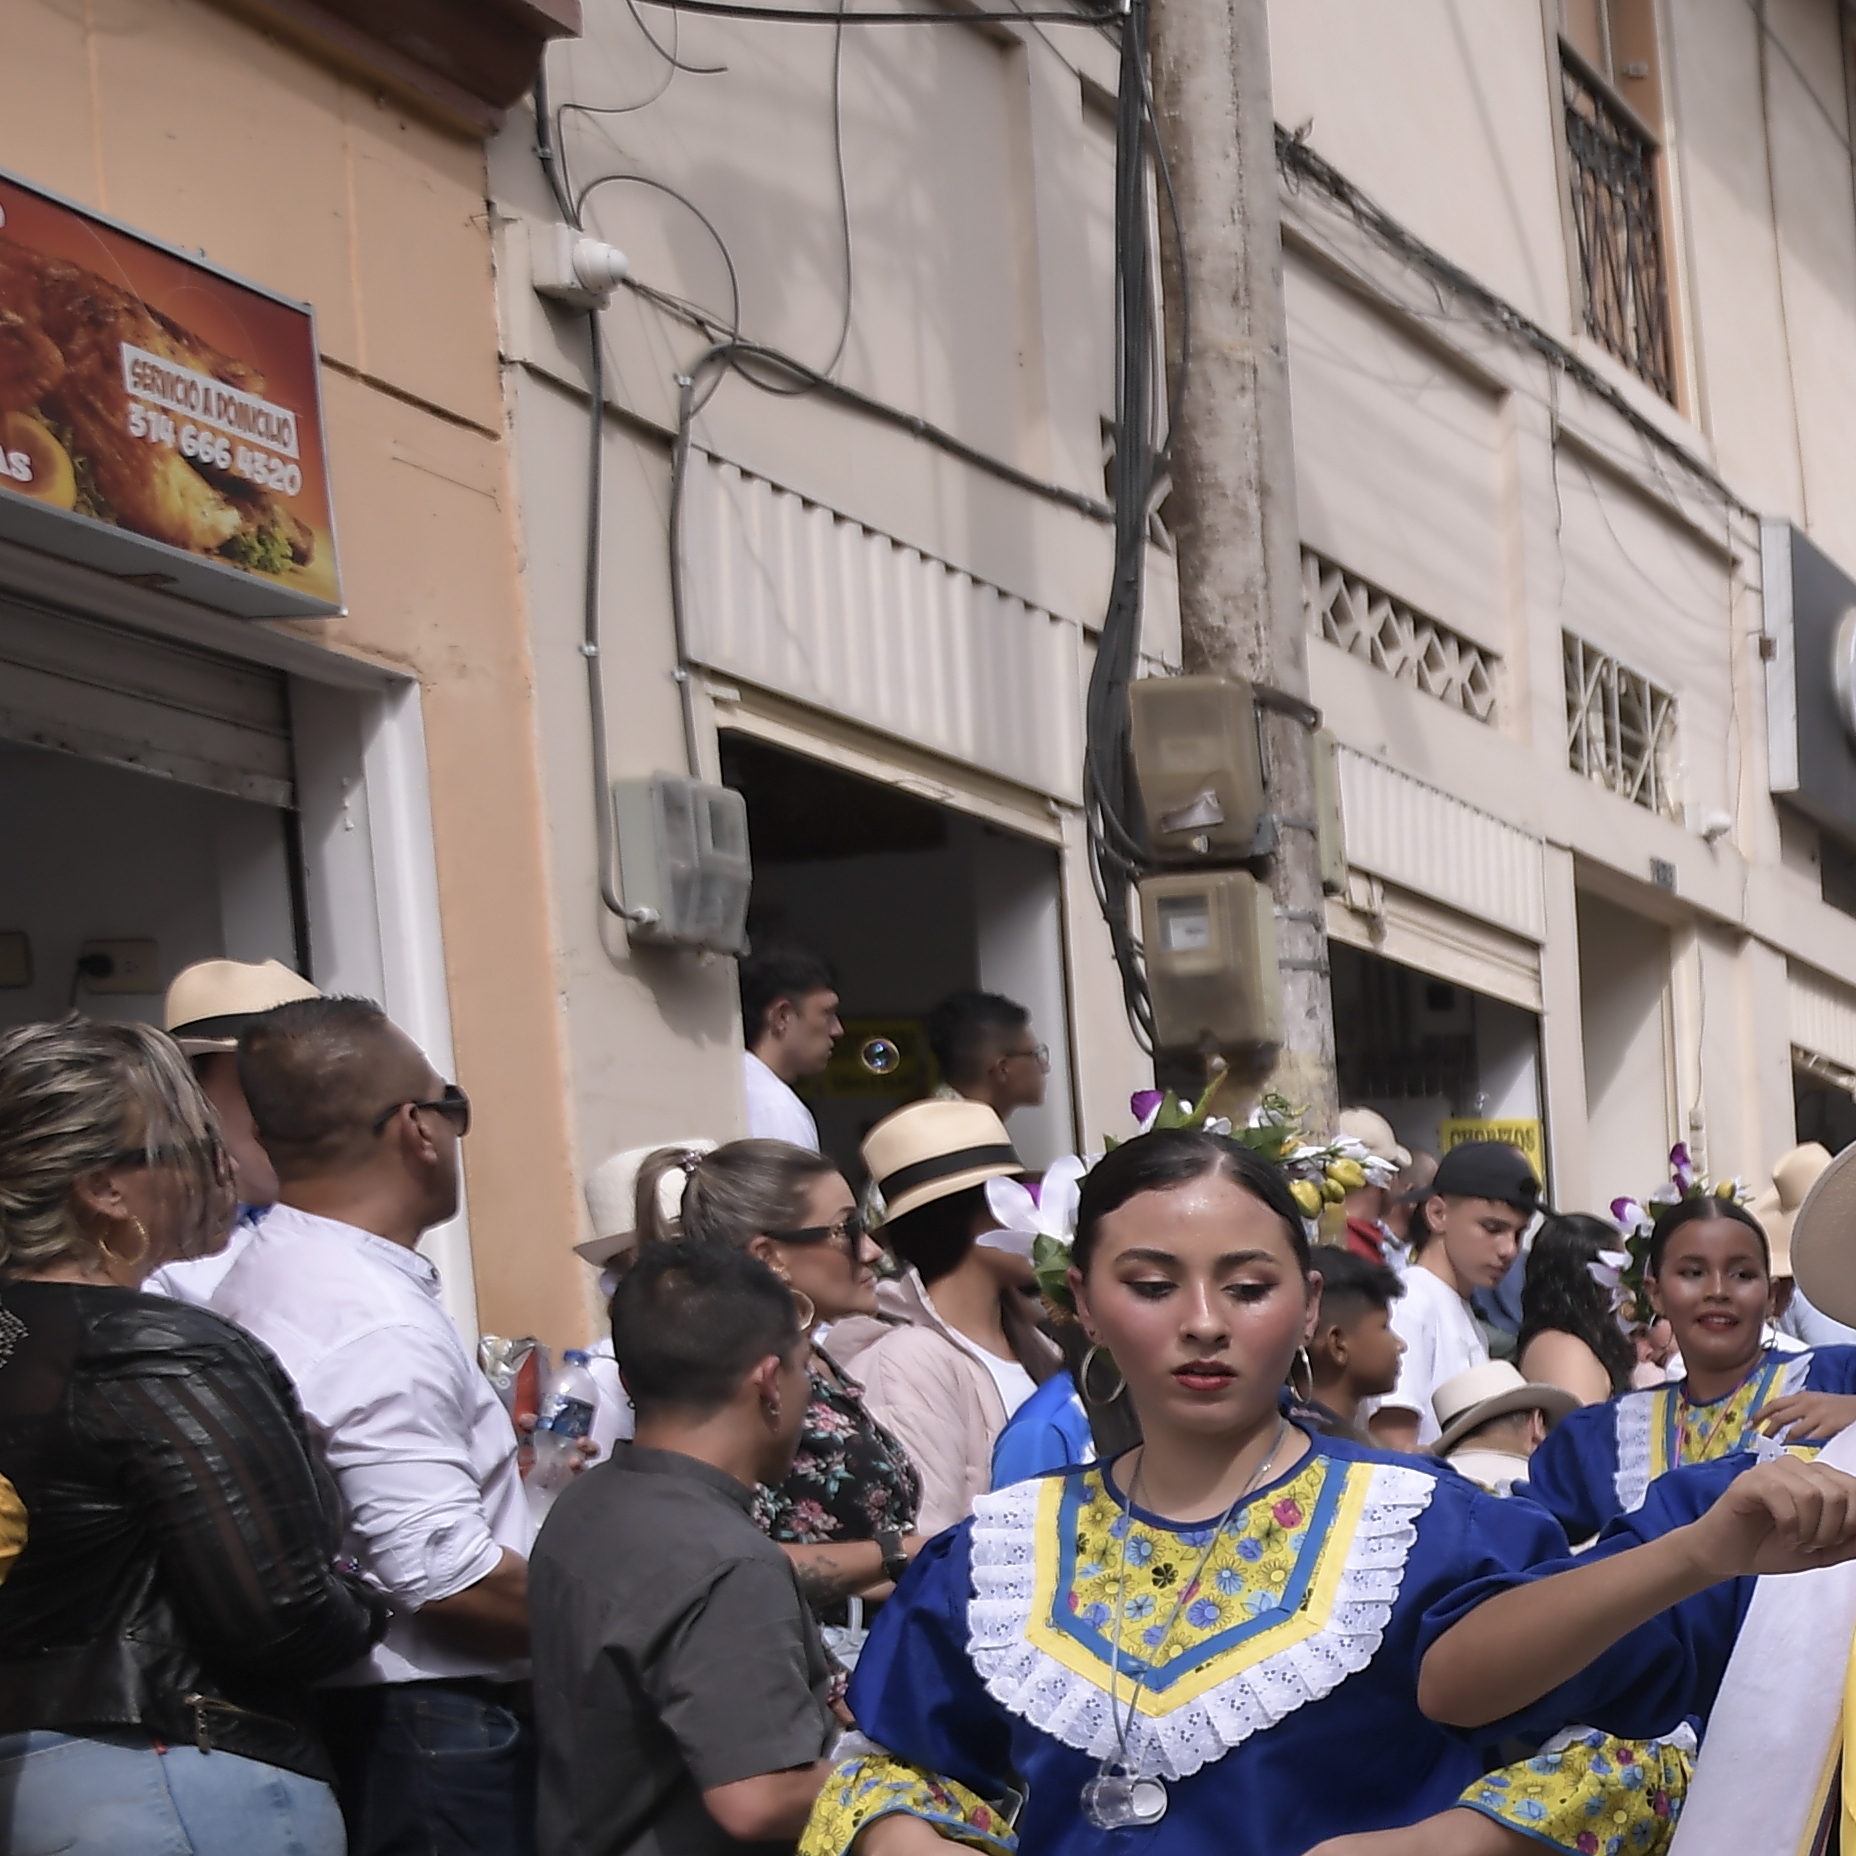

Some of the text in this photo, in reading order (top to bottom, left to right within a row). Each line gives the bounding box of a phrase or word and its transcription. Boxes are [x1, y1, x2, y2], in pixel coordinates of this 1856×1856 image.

[131, 358, 293, 449] SERVICIO A DOMICILIO
[178, 424, 233, 470] 666
